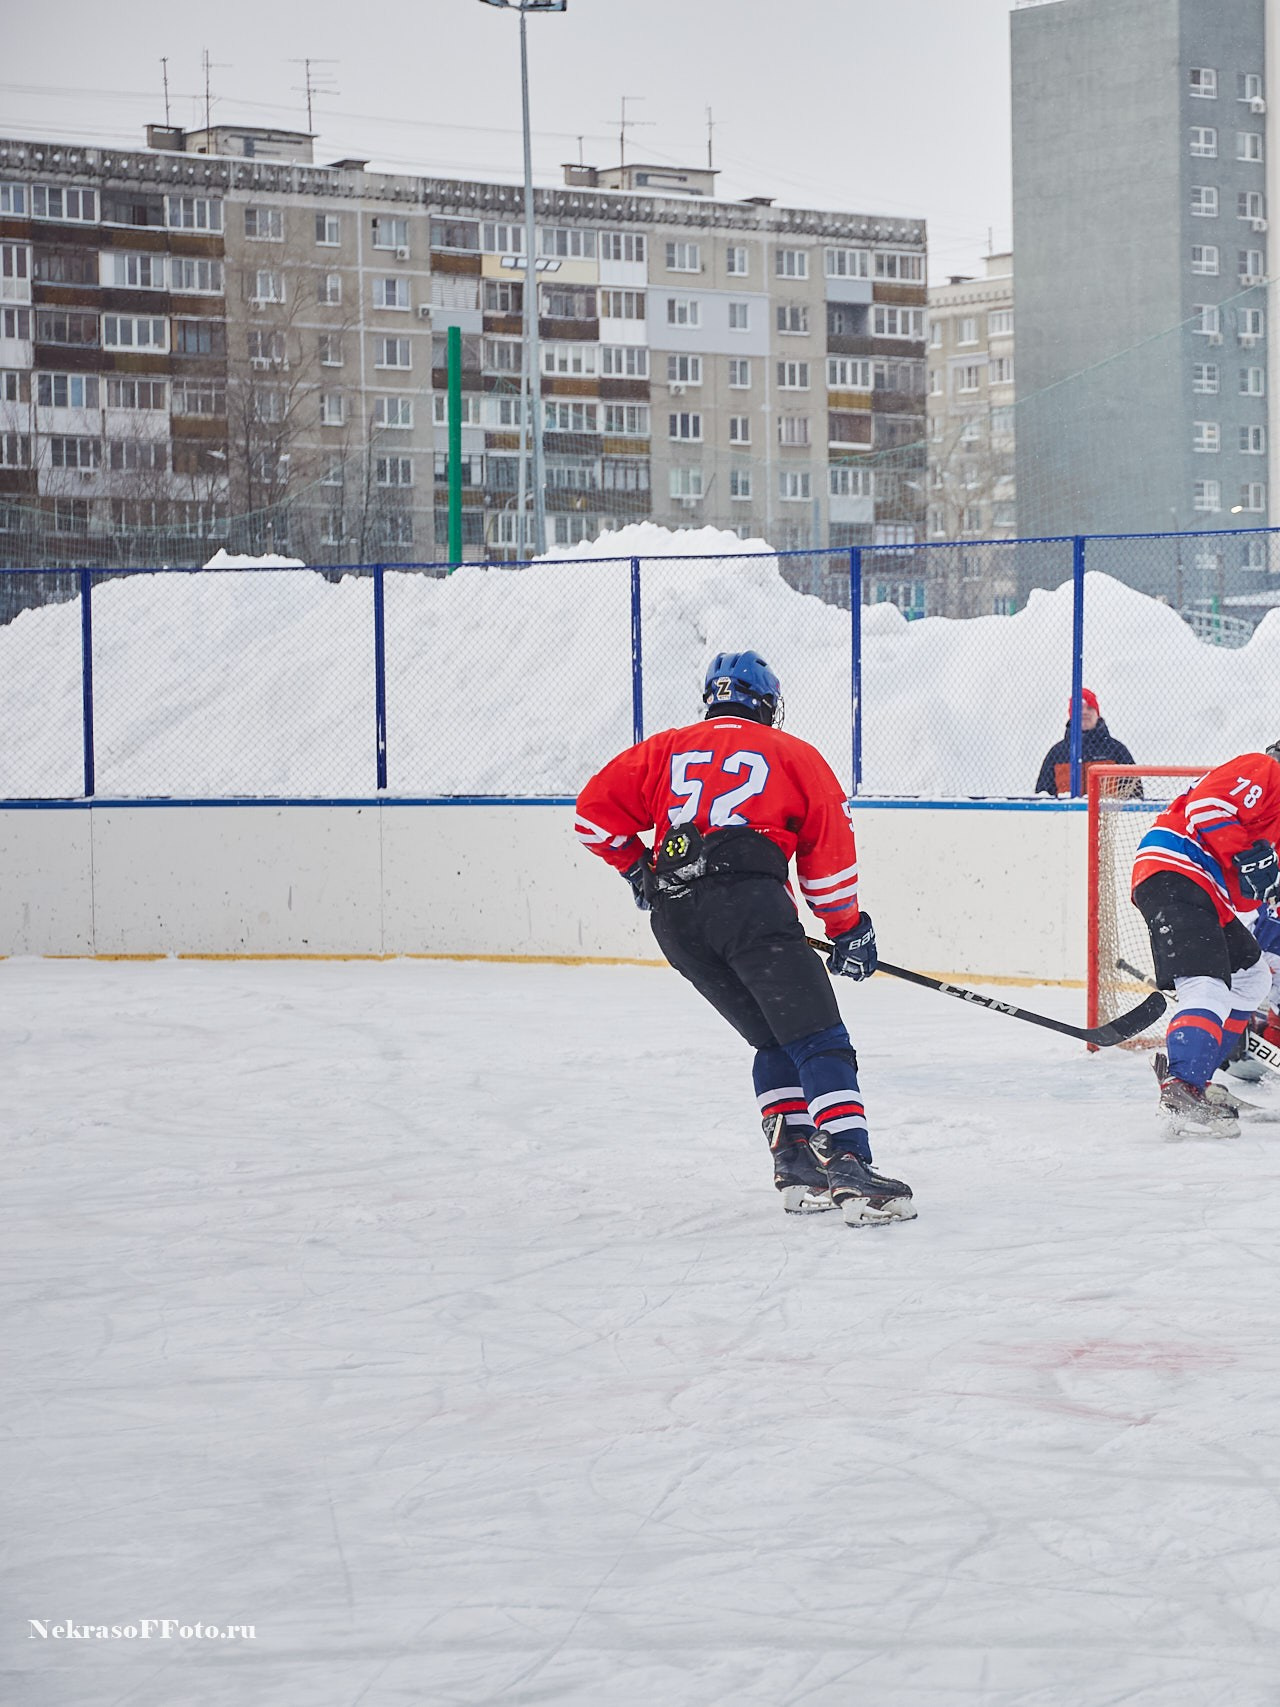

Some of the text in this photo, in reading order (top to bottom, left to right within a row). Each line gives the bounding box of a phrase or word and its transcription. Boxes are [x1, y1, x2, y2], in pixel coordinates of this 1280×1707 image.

[668, 751, 769, 828] 52
[1229, 776, 1263, 809] 78
[939, 982, 1018, 1015] CCM
